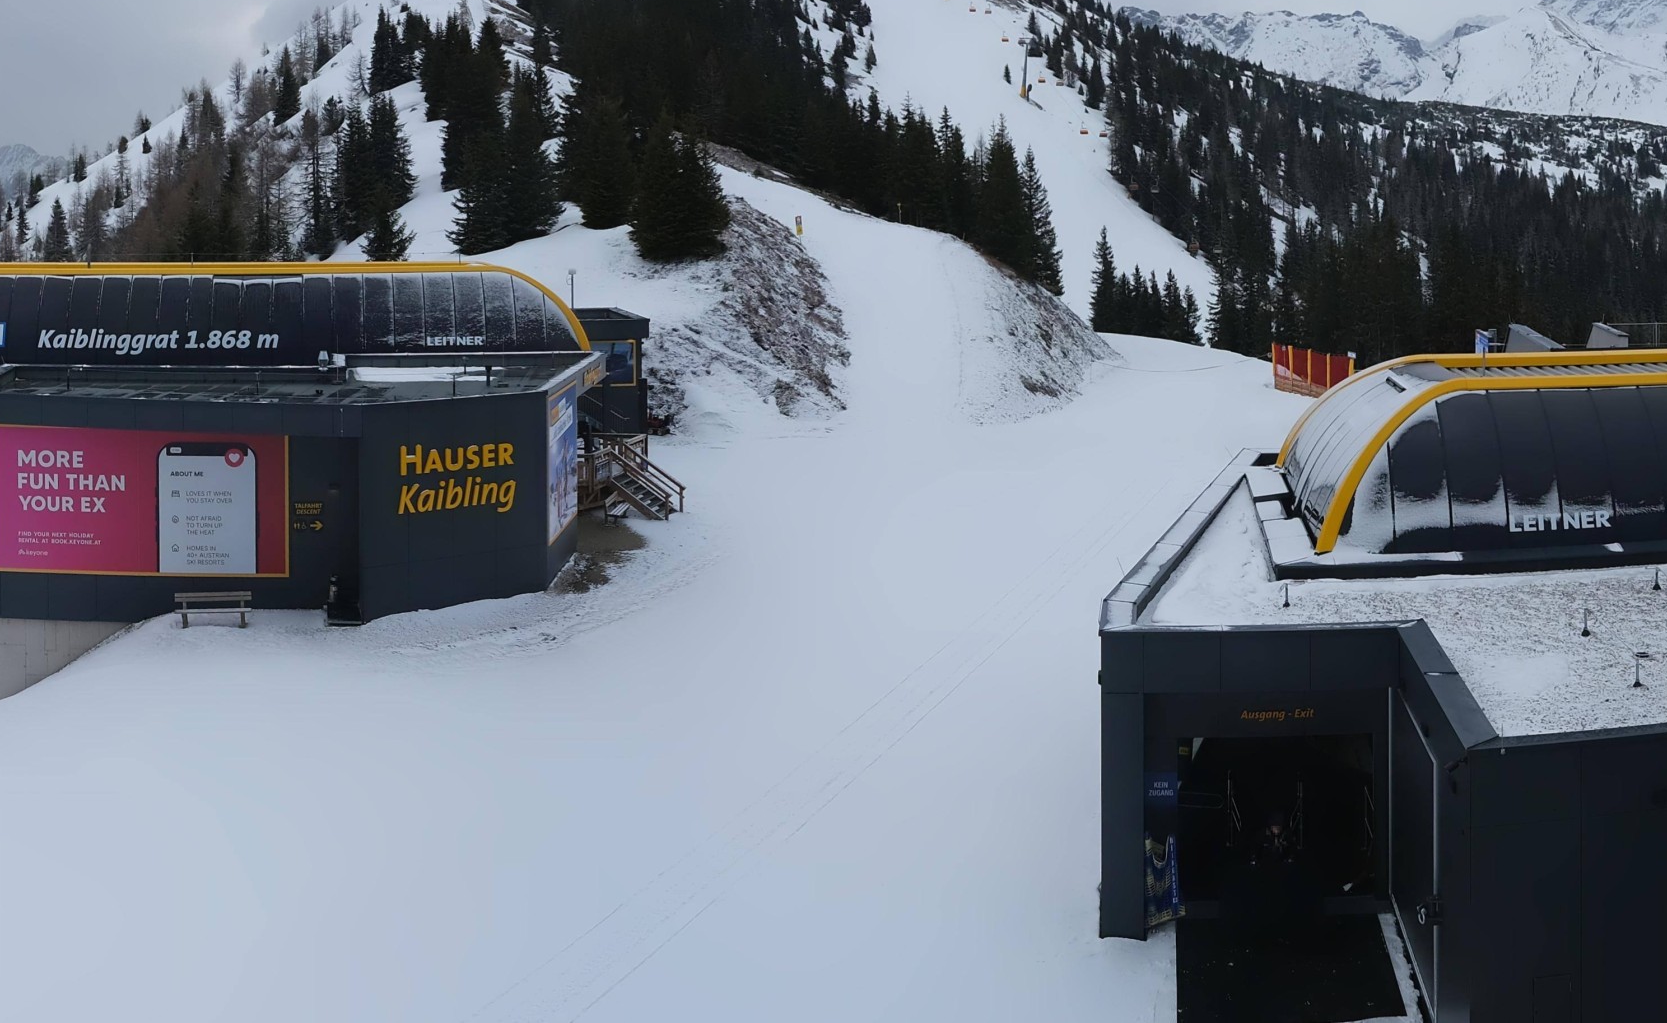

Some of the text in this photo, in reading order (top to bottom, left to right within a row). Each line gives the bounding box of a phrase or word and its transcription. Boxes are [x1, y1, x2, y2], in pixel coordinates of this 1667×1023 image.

[37, 328, 280, 355] Kaiblinggrat 1.868 m
[426, 336, 484, 346] LEITNER
[17, 449, 84, 468] MORE
[400, 442, 515, 476] HAUSER
[17, 472, 126, 491] FUN THAN
[18, 495, 106, 513] YOUR EX
[398, 476, 517, 515] Kaibling
[1509, 510, 1612, 533] LEITNER
[26, 549, 48, 557] keyone
[1240, 710, 1285, 721] Ausgang
[1294, 708, 1315, 718] Exit
